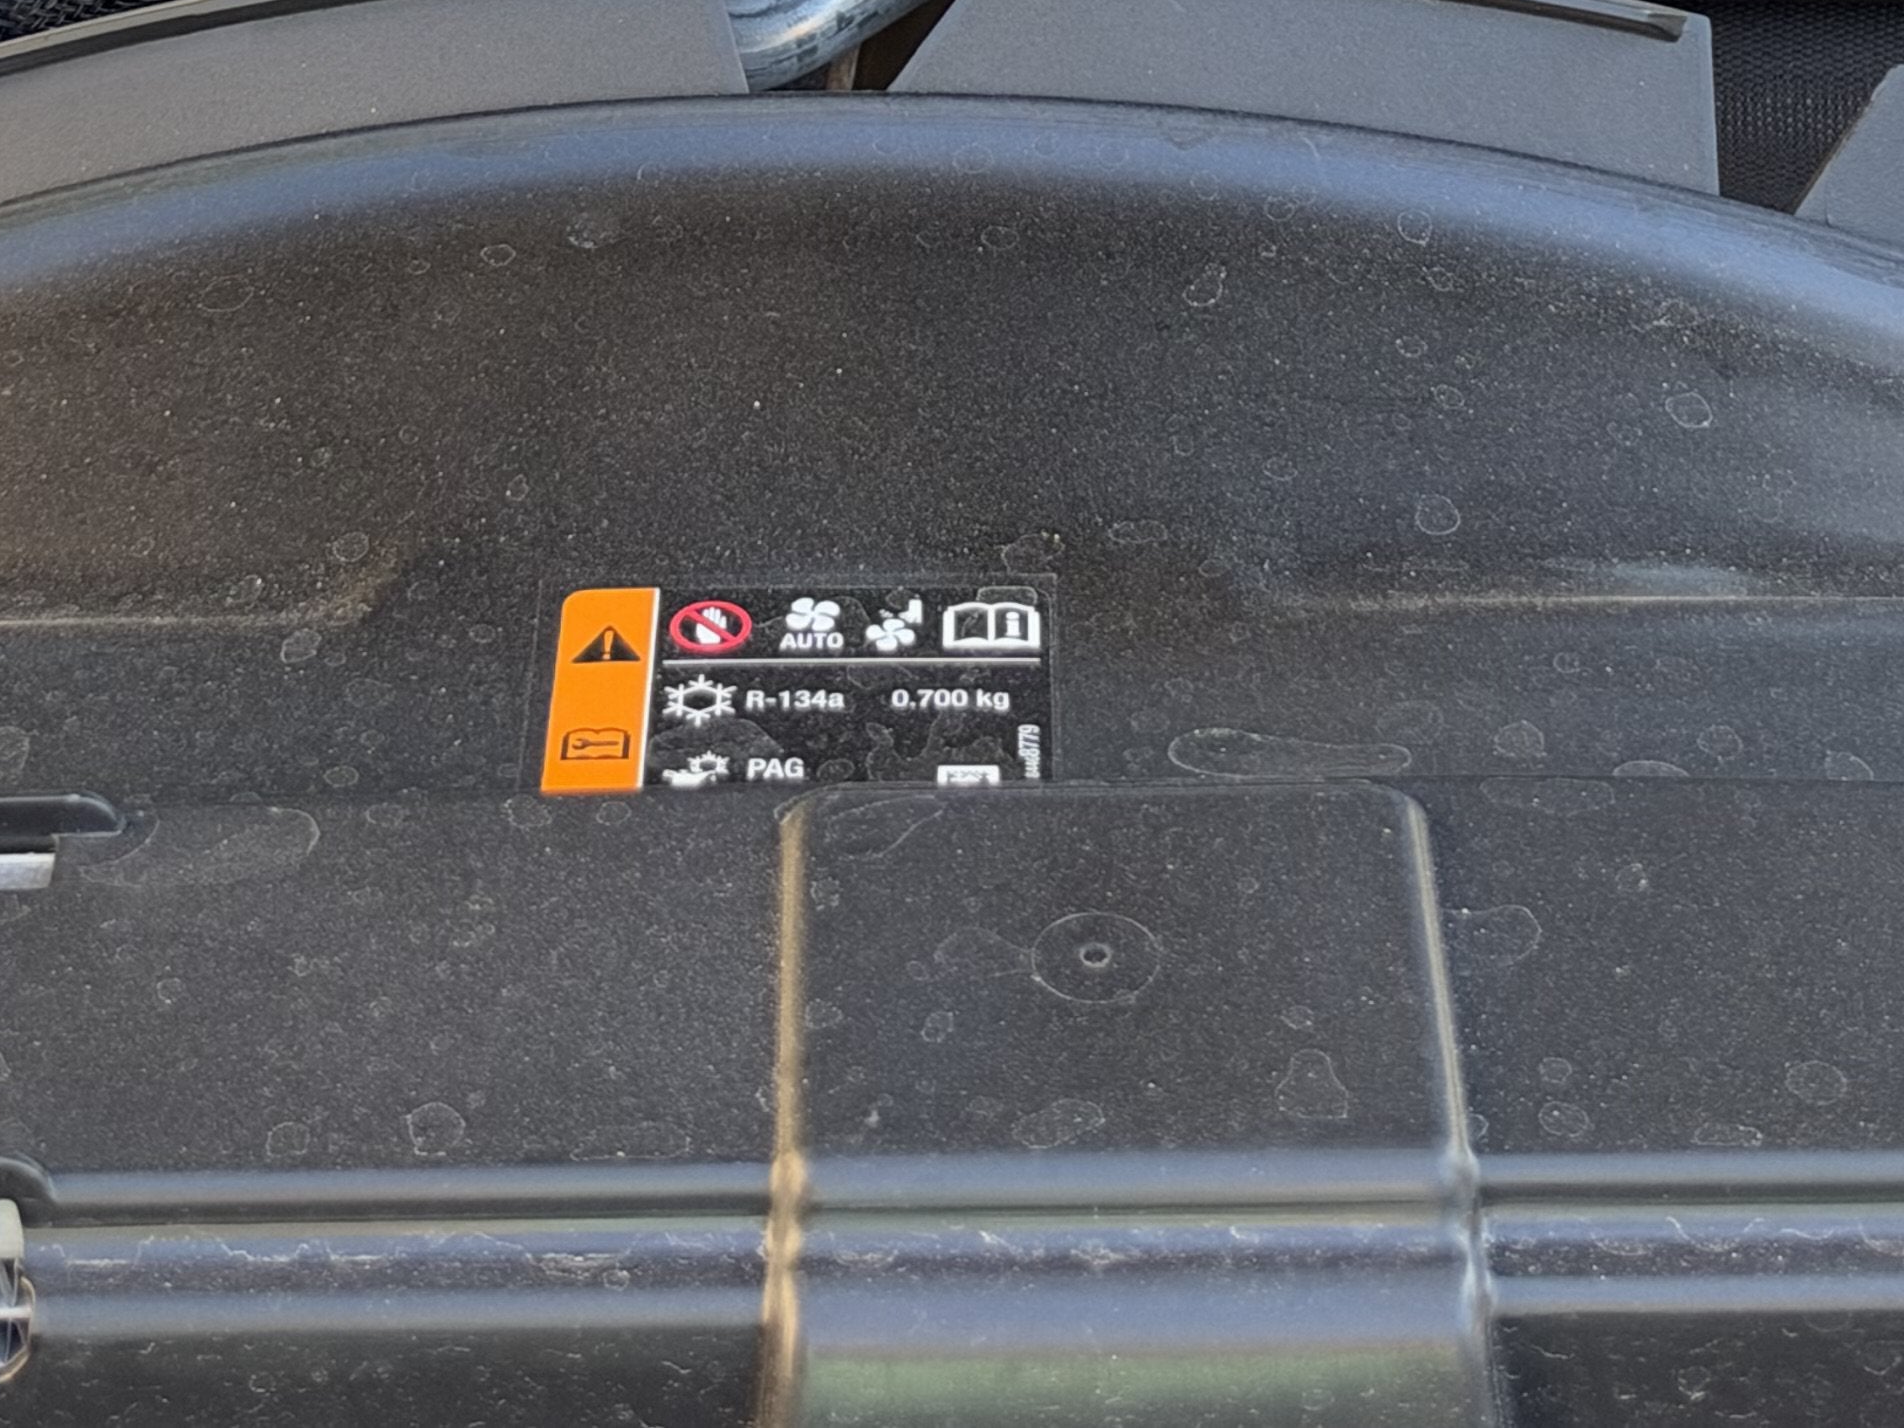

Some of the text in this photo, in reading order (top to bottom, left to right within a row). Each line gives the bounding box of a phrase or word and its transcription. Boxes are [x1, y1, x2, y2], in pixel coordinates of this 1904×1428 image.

[779, 631, 845, 651] AUTO
[745, 688, 1011, 711] R-134a 0.700 kg
[746, 757, 806, 781] PAG
